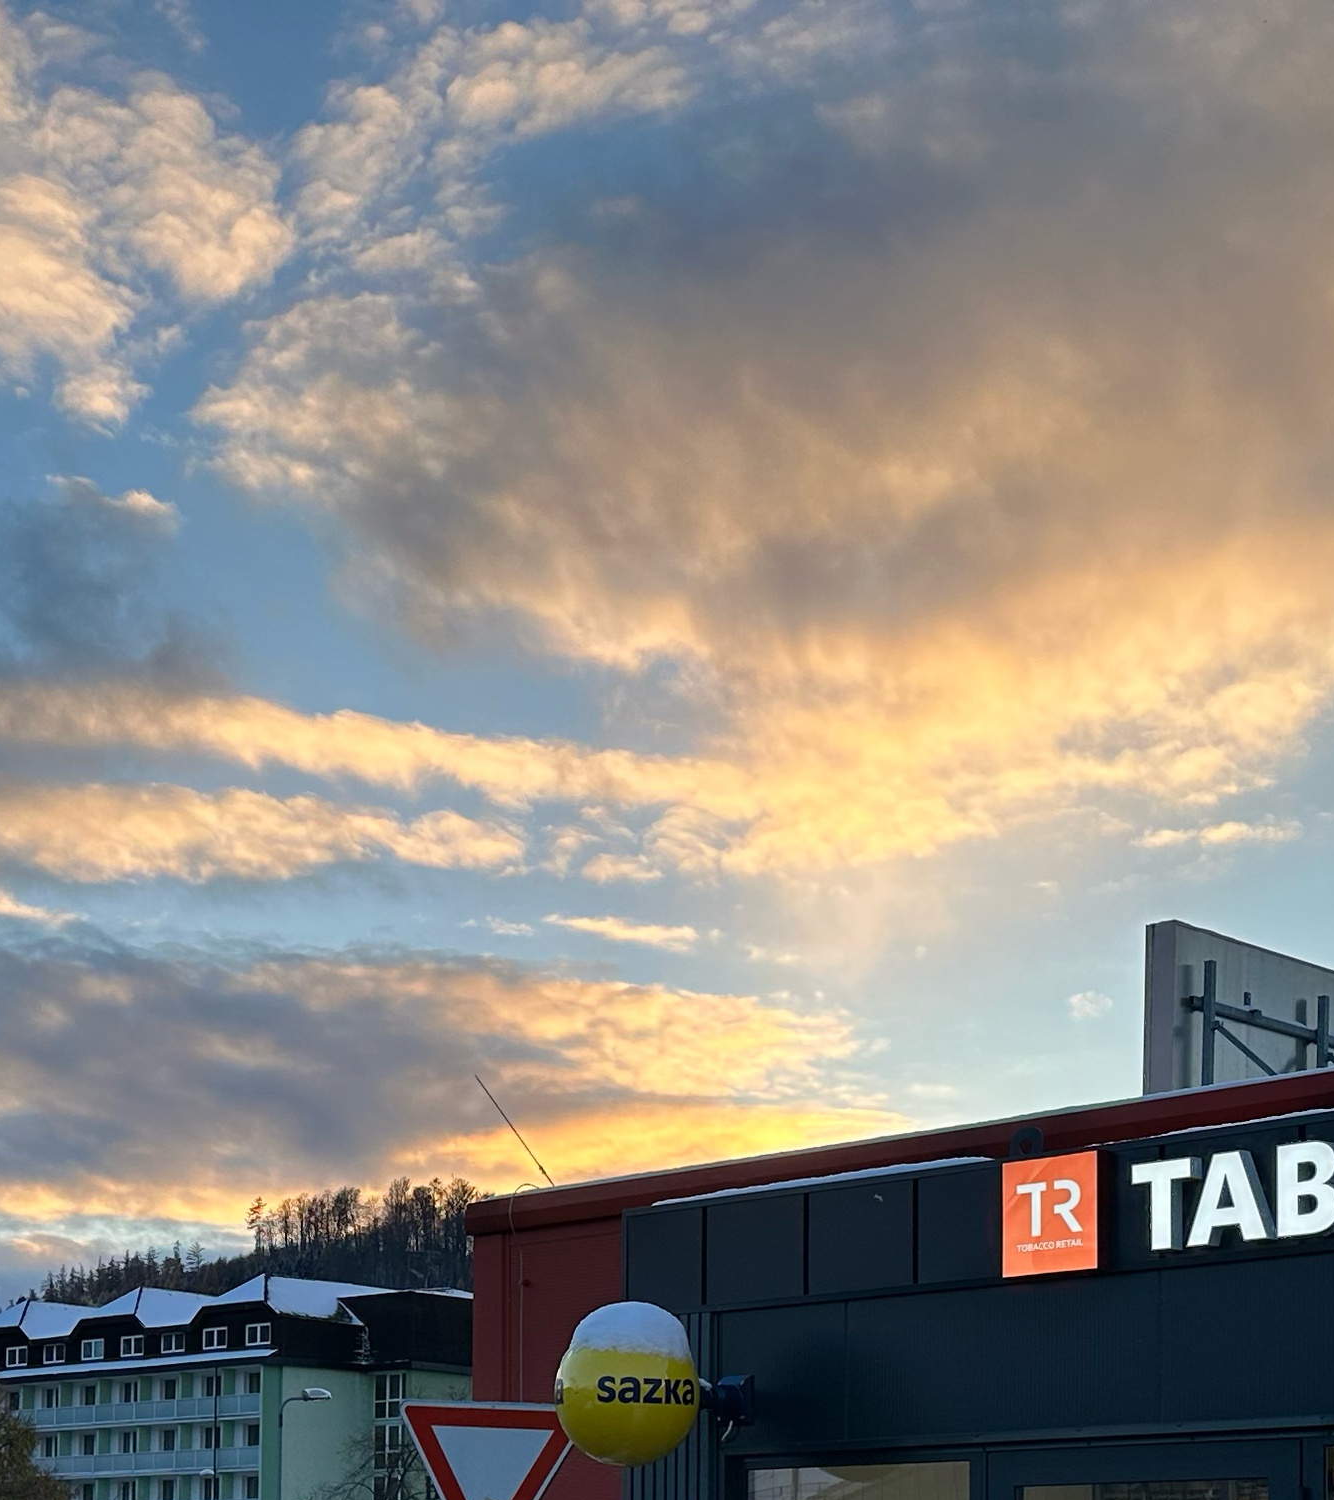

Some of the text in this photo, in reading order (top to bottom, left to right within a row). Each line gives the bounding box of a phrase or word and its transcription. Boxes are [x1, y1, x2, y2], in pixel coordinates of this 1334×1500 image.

[1015, 1178, 1084, 1238] TR
[1016, 1238, 1084, 1253] TOBACCO RETAIL
[596, 1375, 695, 1406] sazka
